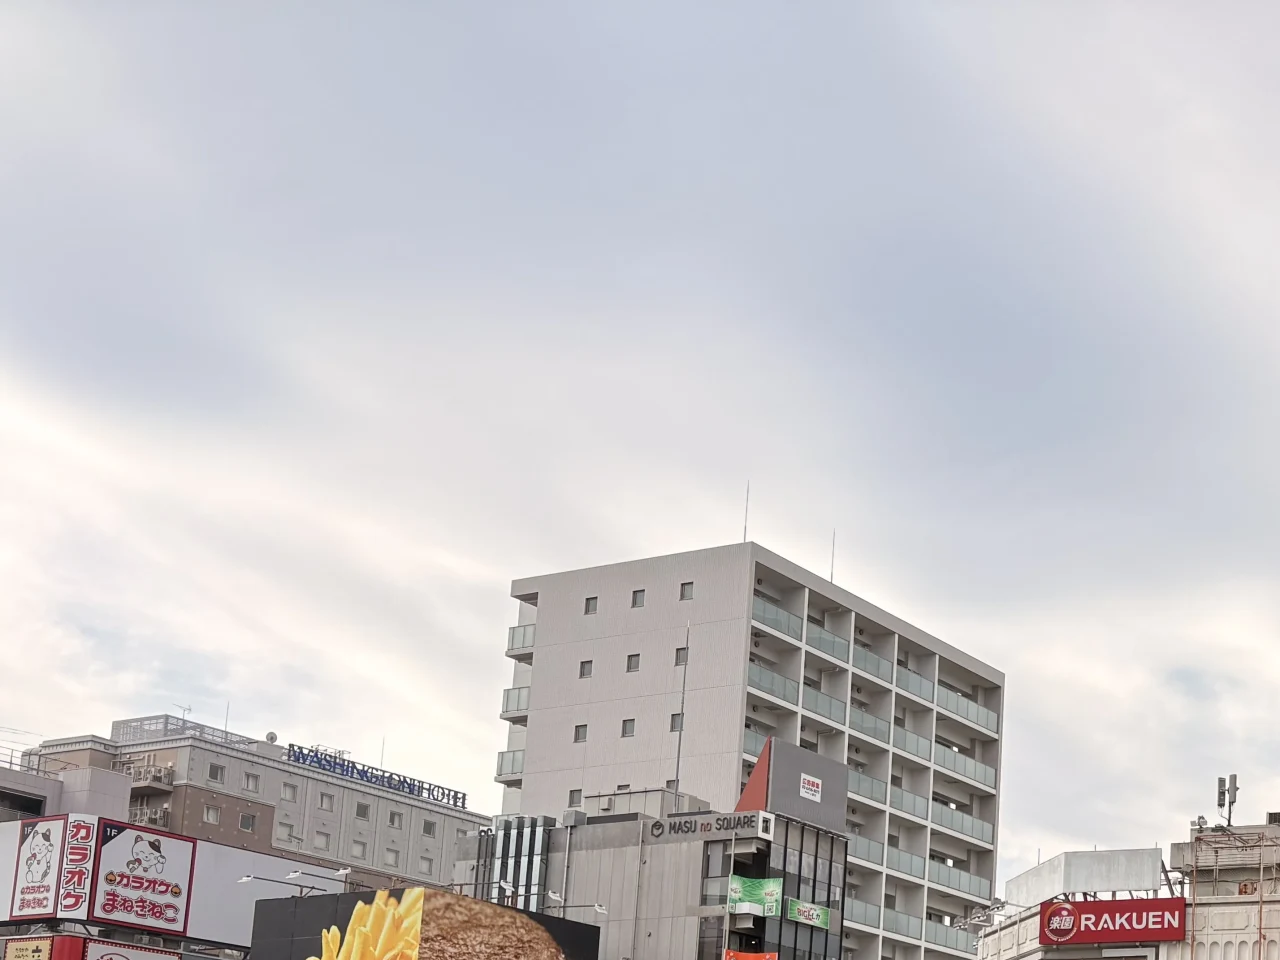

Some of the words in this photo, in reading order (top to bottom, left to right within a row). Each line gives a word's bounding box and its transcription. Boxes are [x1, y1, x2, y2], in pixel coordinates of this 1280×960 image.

[287, 743, 416, 797] WASHINGTON
[416, 779, 468, 810] HOTEL
[106, 827, 118, 837] 1F
[668, 820, 697, 834] MASU
[700, 822, 712, 833] no
[715, 814, 756, 831] SQUARE
[61, 820, 95, 912] カラオケ
[116, 872, 172, 895] カラオケ
[101, 890, 180, 923] まねきねこ
[1049, 916, 1074, 930] 楽園
[1080, 911, 1180, 931] RAKUEN
